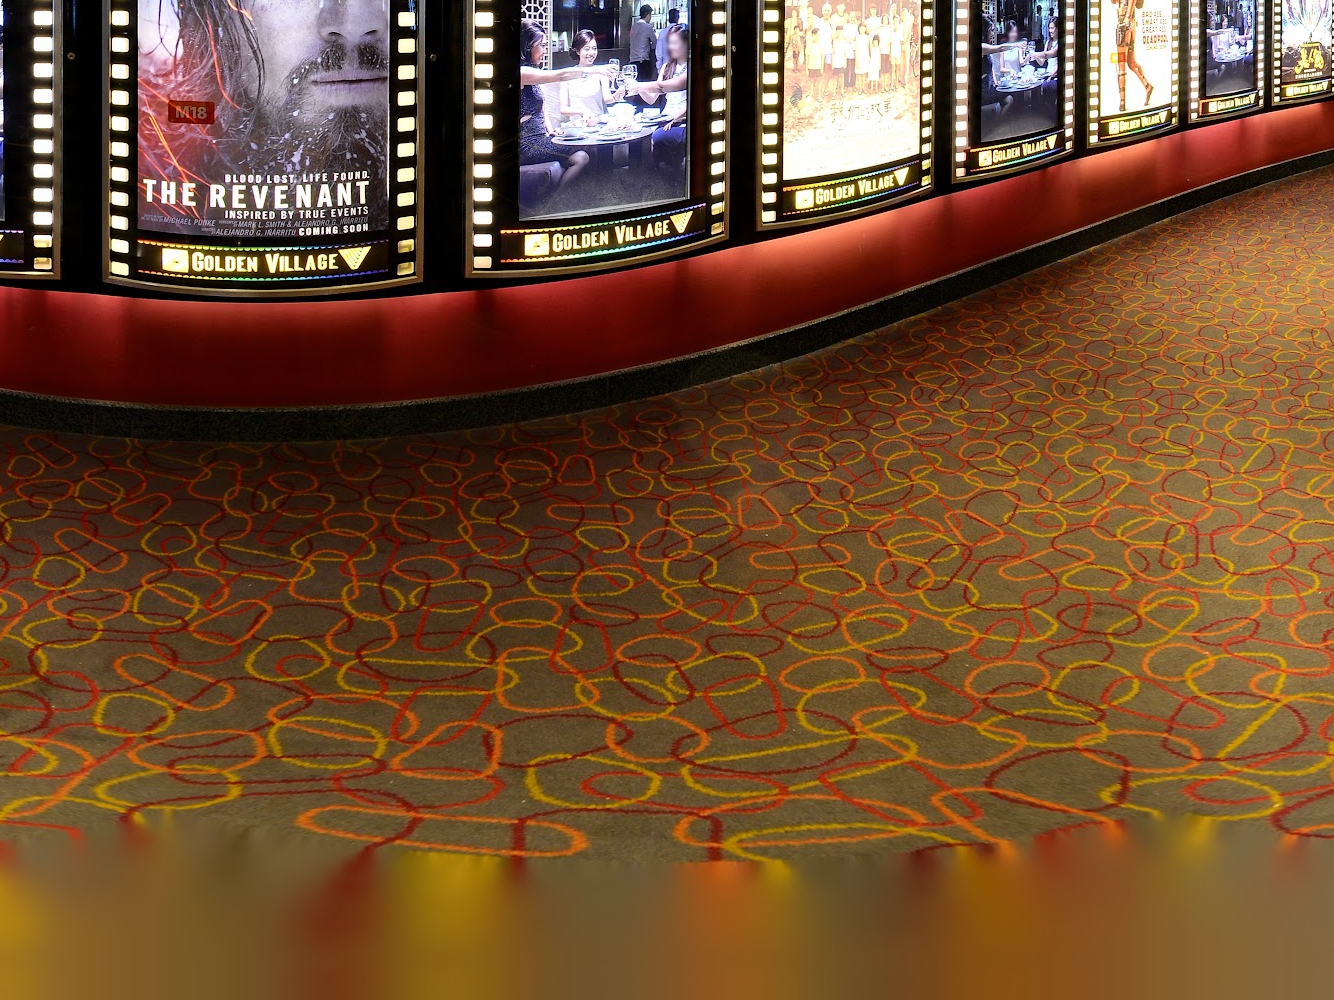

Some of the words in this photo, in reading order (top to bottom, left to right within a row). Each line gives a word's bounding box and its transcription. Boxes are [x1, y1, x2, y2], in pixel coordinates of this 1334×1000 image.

[175, 105, 208, 121] M18
[225, 174, 261, 184] BLOOD
[267, 174, 297, 184] LOST.
[303, 173, 329, 183] LIFE
[333, 170, 370, 182] FOUND.
[143, 179, 197, 207] THE
[209, 181, 370, 210] REVENANT
[815, 184, 855, 204] GOLDEN
[858, 174, 895, 196] VILLAGE
[225, 209, 276, 220] INSPIRED
[281, 210, 295, 220] BY
[299, 208, 326, 219] TRUE
[331, 206, 369, 218] EVENTS
[299, 225, 339, 236] COMING
[343, 224, 369, 234] SOON
[552, 231, 609, 254] GOLDEN
[615, 219, 671, 246] VILLAGE
[192, 252, 258, 273] GOLDEN
[265, 252, 339, 274] VILLAGE
